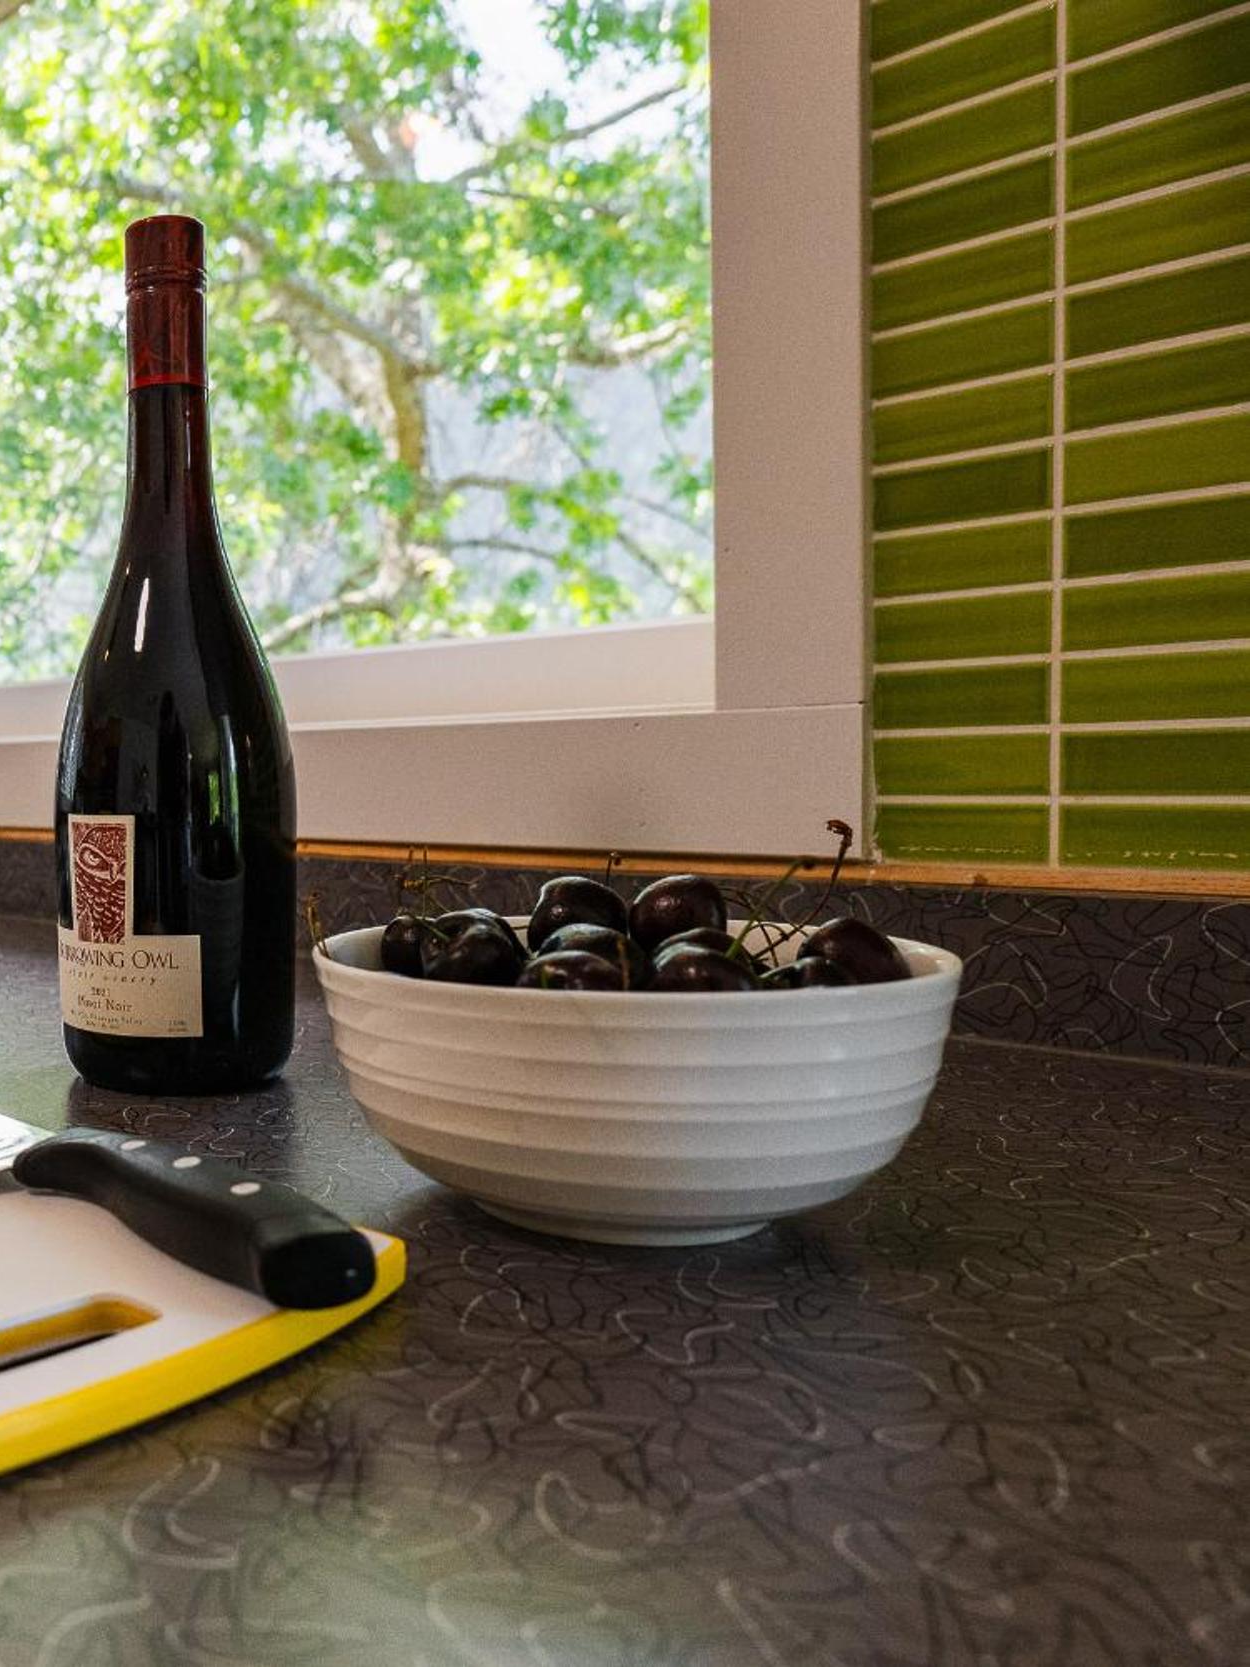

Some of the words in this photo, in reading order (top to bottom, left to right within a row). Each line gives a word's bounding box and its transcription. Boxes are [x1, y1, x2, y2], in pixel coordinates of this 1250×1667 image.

[132, 949, 179, 970] OWL
[77, 993, 102, 1009] Pinot
[105, 998, 133, 1012] Noir
